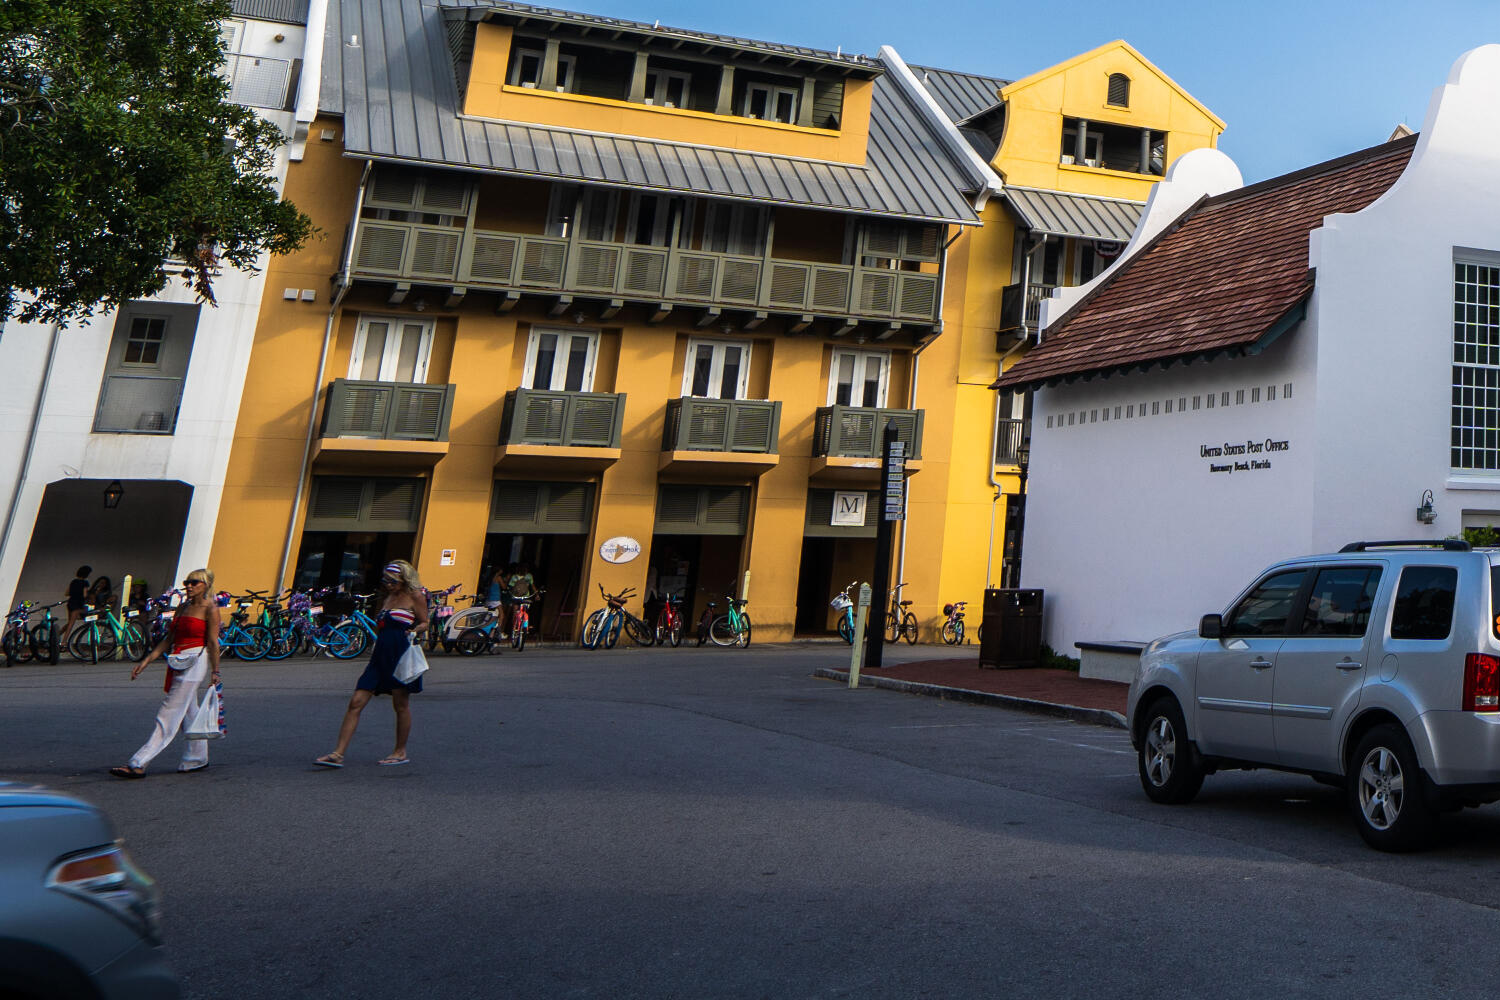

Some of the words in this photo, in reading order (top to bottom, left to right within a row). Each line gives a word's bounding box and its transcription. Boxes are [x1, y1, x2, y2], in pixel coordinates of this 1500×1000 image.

[1247, 440, 1264, 454] POST
[1251, 459, 1272, 470] Florida
[839, 496, 860, 514] M
